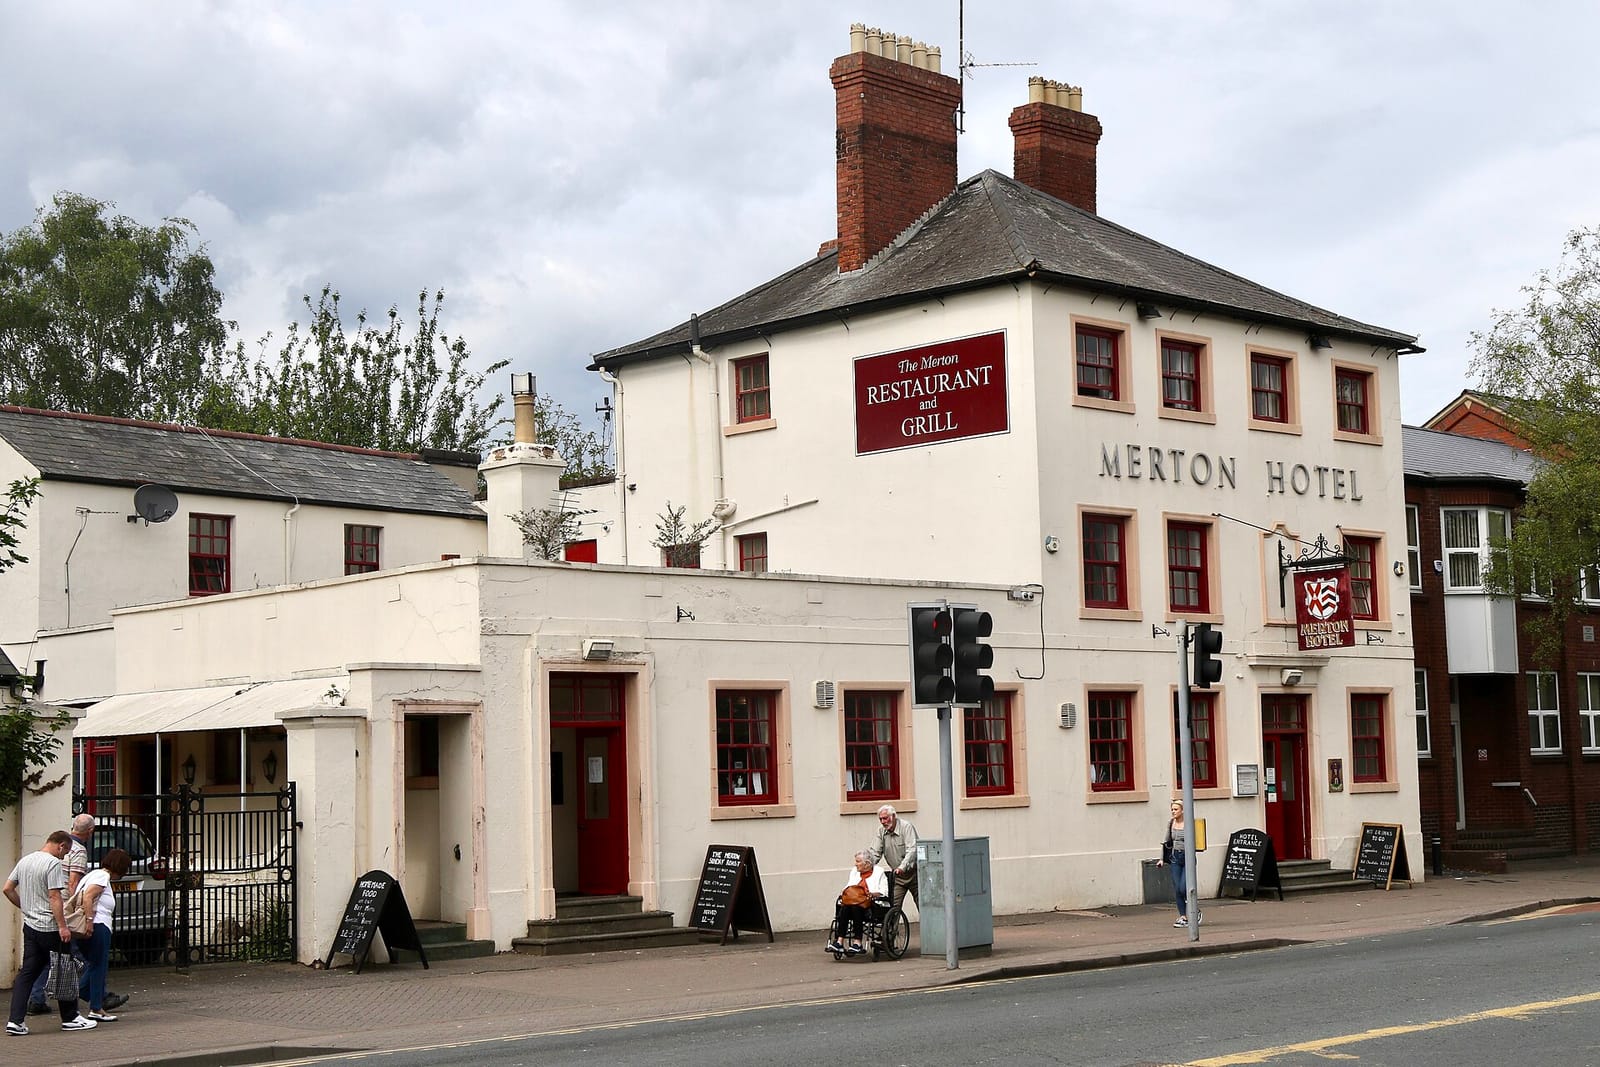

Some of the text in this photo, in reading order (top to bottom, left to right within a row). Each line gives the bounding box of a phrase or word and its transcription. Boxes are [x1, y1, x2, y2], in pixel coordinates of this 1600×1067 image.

[898, 354, 959, 374] The Merton
[867, 365, 993, 405] RESTAURANT
[919, 396, 938, 410] and
[901, 411, 958, 437] GRILL
[1098, 441, 1363, 502] MERTON HOTEL
[1300, 620, 1349, 636] MERTON
[1305, 633, 1344, 648] HOTEL
[1233, 838, 1262, 847] ENTRANCE
[360, 881, 386, 889] HOMEMADE
